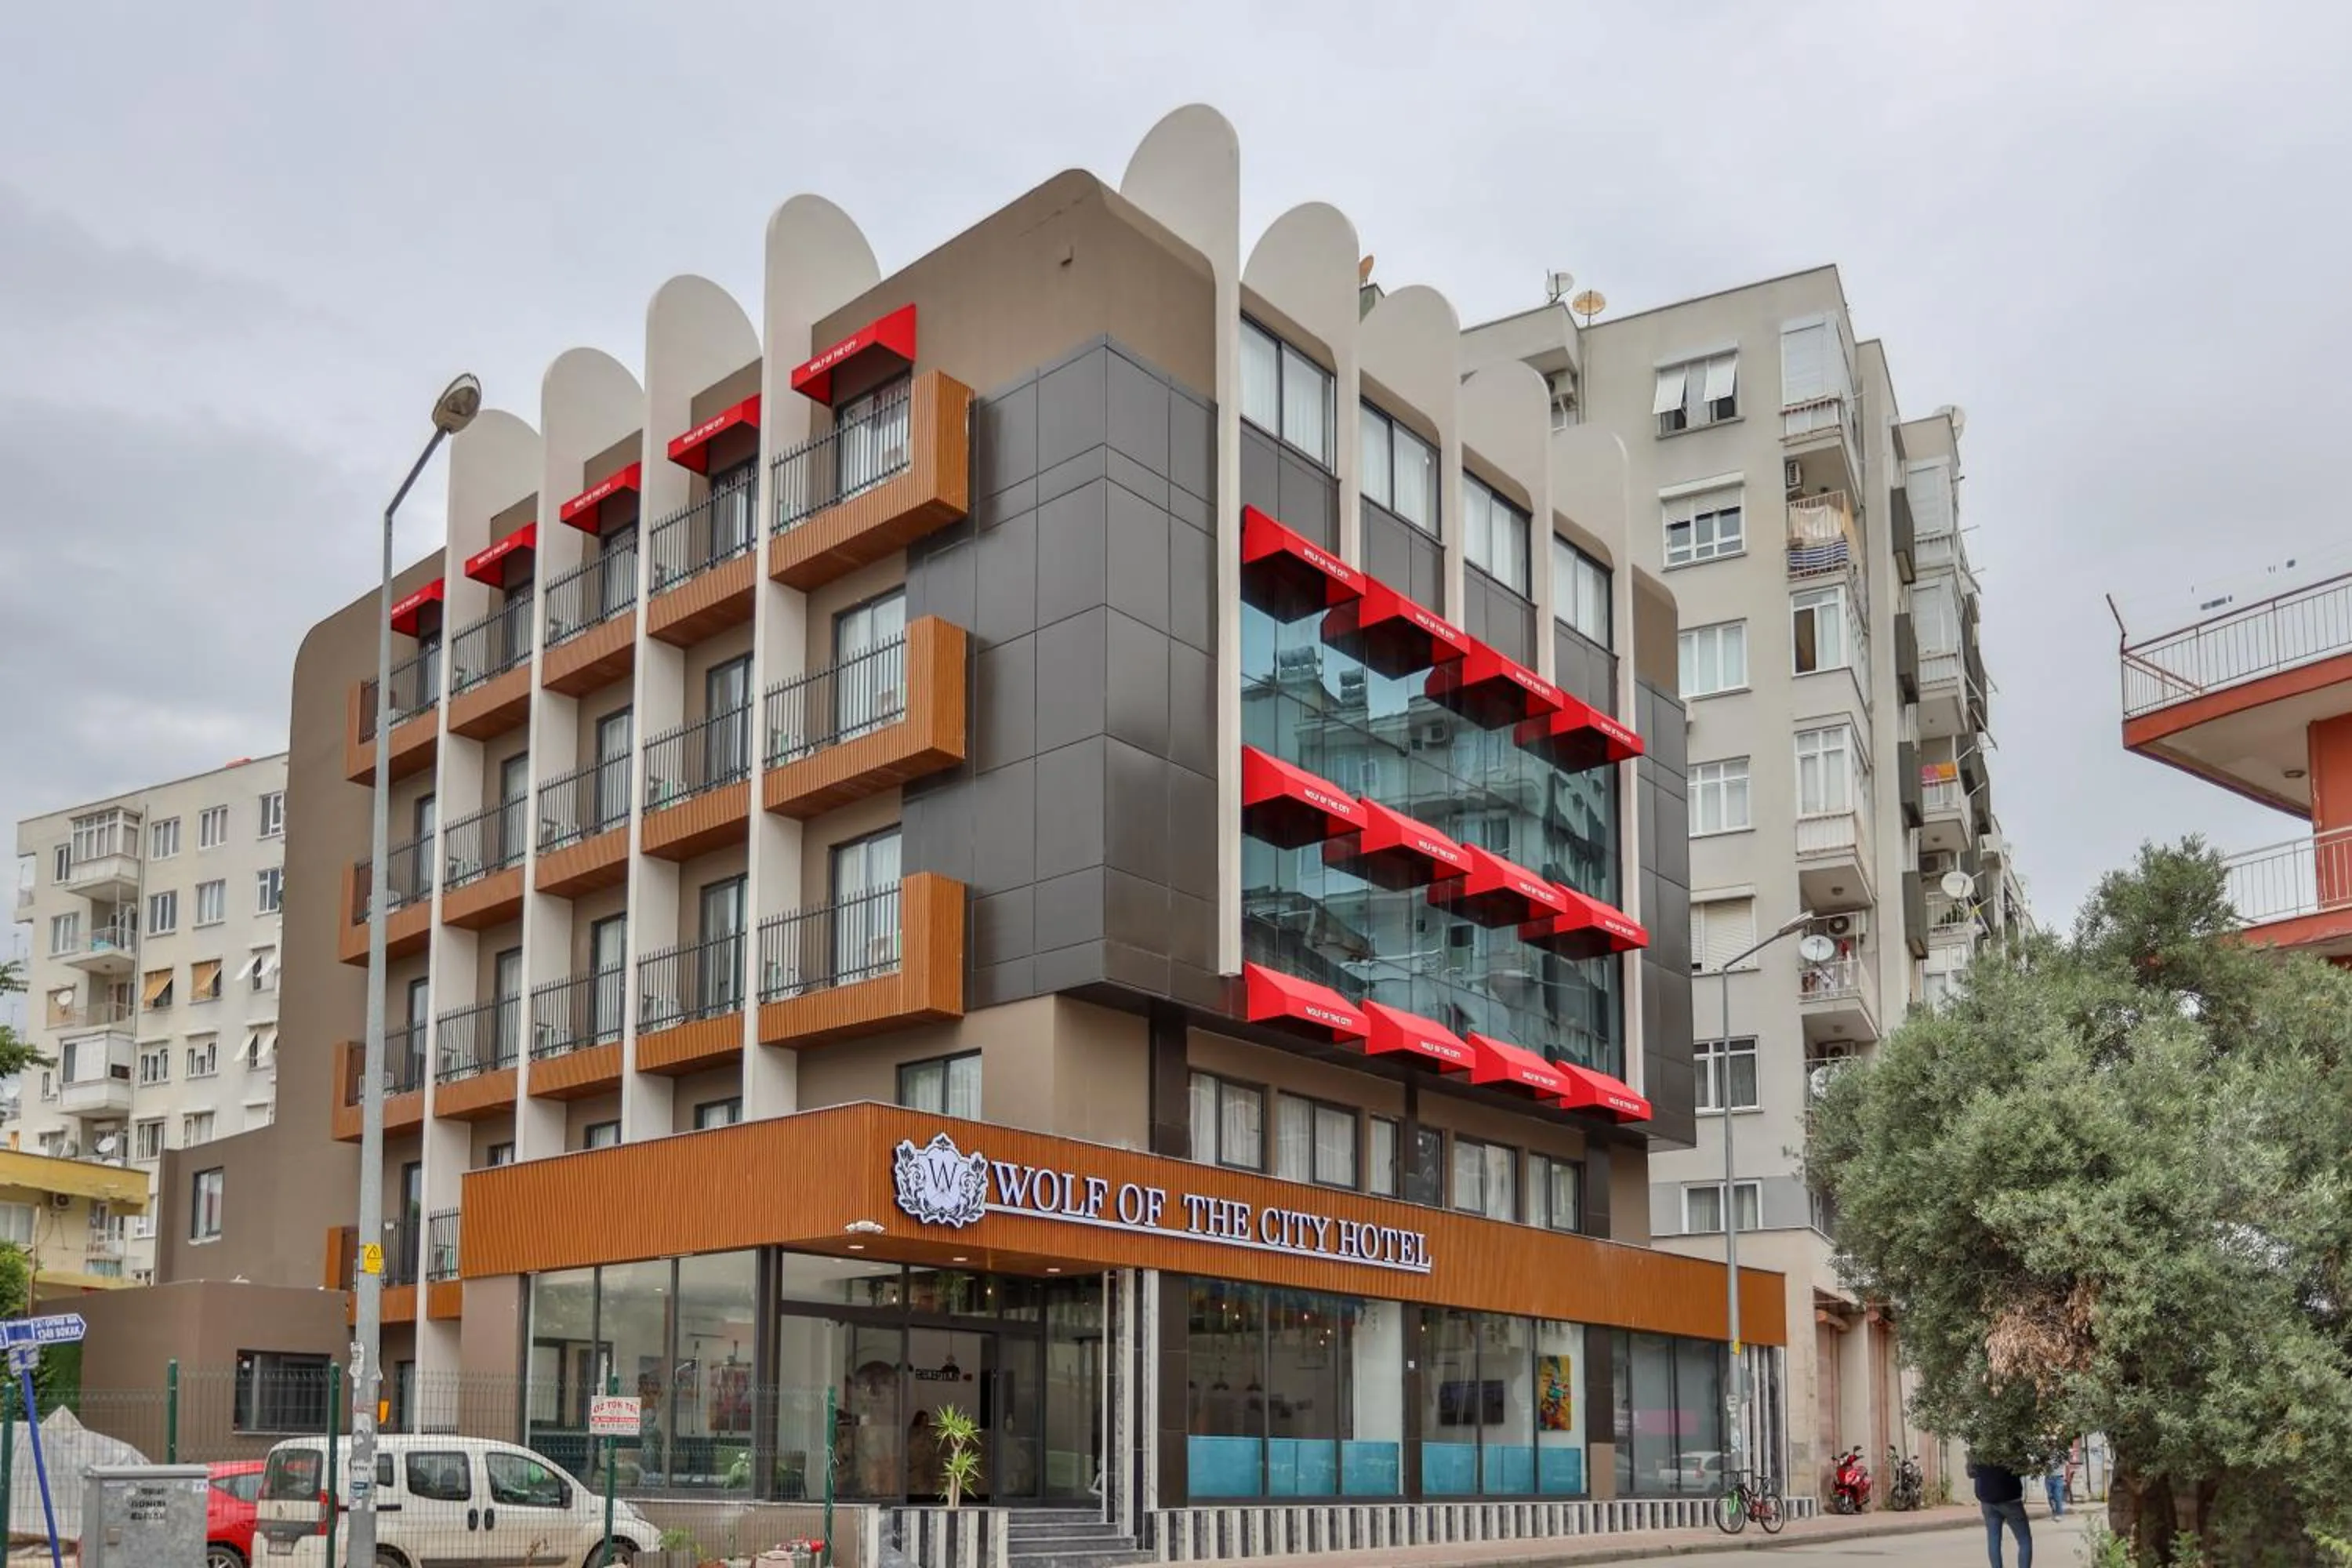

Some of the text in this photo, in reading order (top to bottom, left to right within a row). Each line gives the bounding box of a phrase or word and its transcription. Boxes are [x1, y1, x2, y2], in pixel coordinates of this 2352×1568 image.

[928, 1158, 957, 1192] W
[990, 1160, 1432, 1269] WOLF OF THE CITY HOTEL
